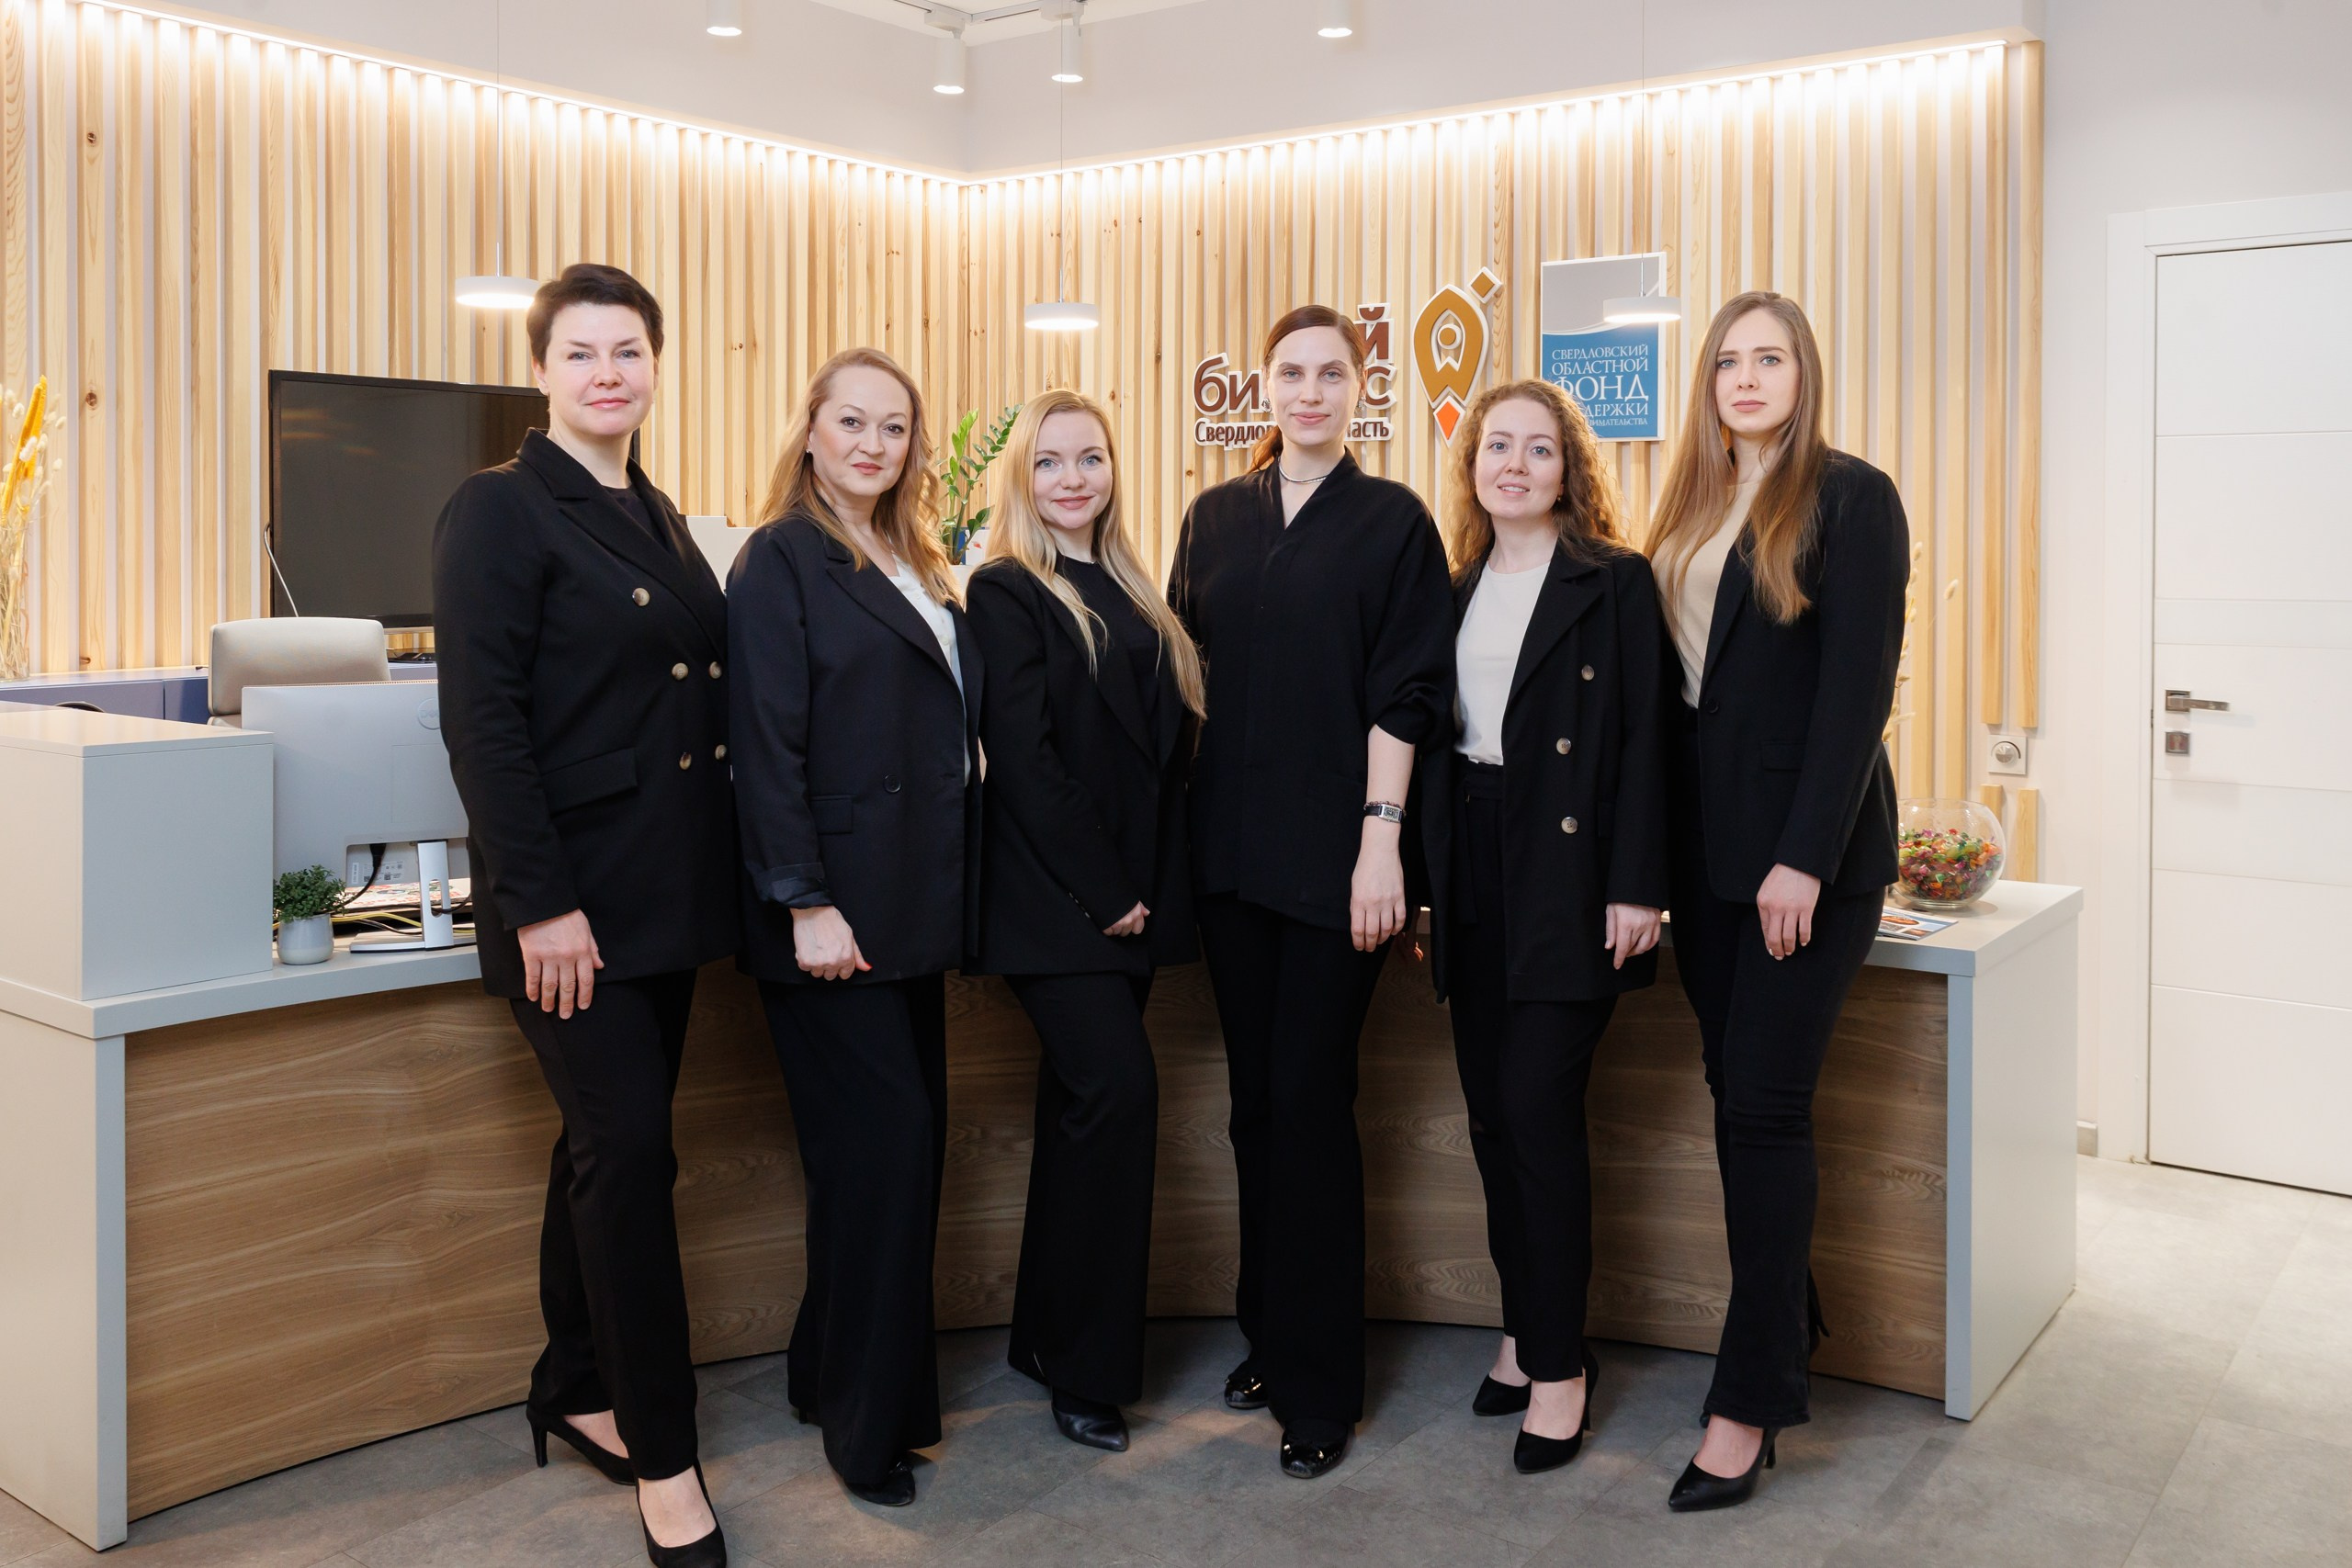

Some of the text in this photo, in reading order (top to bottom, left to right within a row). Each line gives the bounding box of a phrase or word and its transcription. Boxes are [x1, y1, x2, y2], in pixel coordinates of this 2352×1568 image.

[1551, 344, 1649, 360] СВЕРДЛОВСКИЙ
[1551, 356, 1649, 376] ОБЛАСТНОЙ
[1193, 355, 1392, 413] бис
[1585, 402, 1649, 418] ДЕРЖКИ
[1194, 421, 1389, 447] Свердло асть
